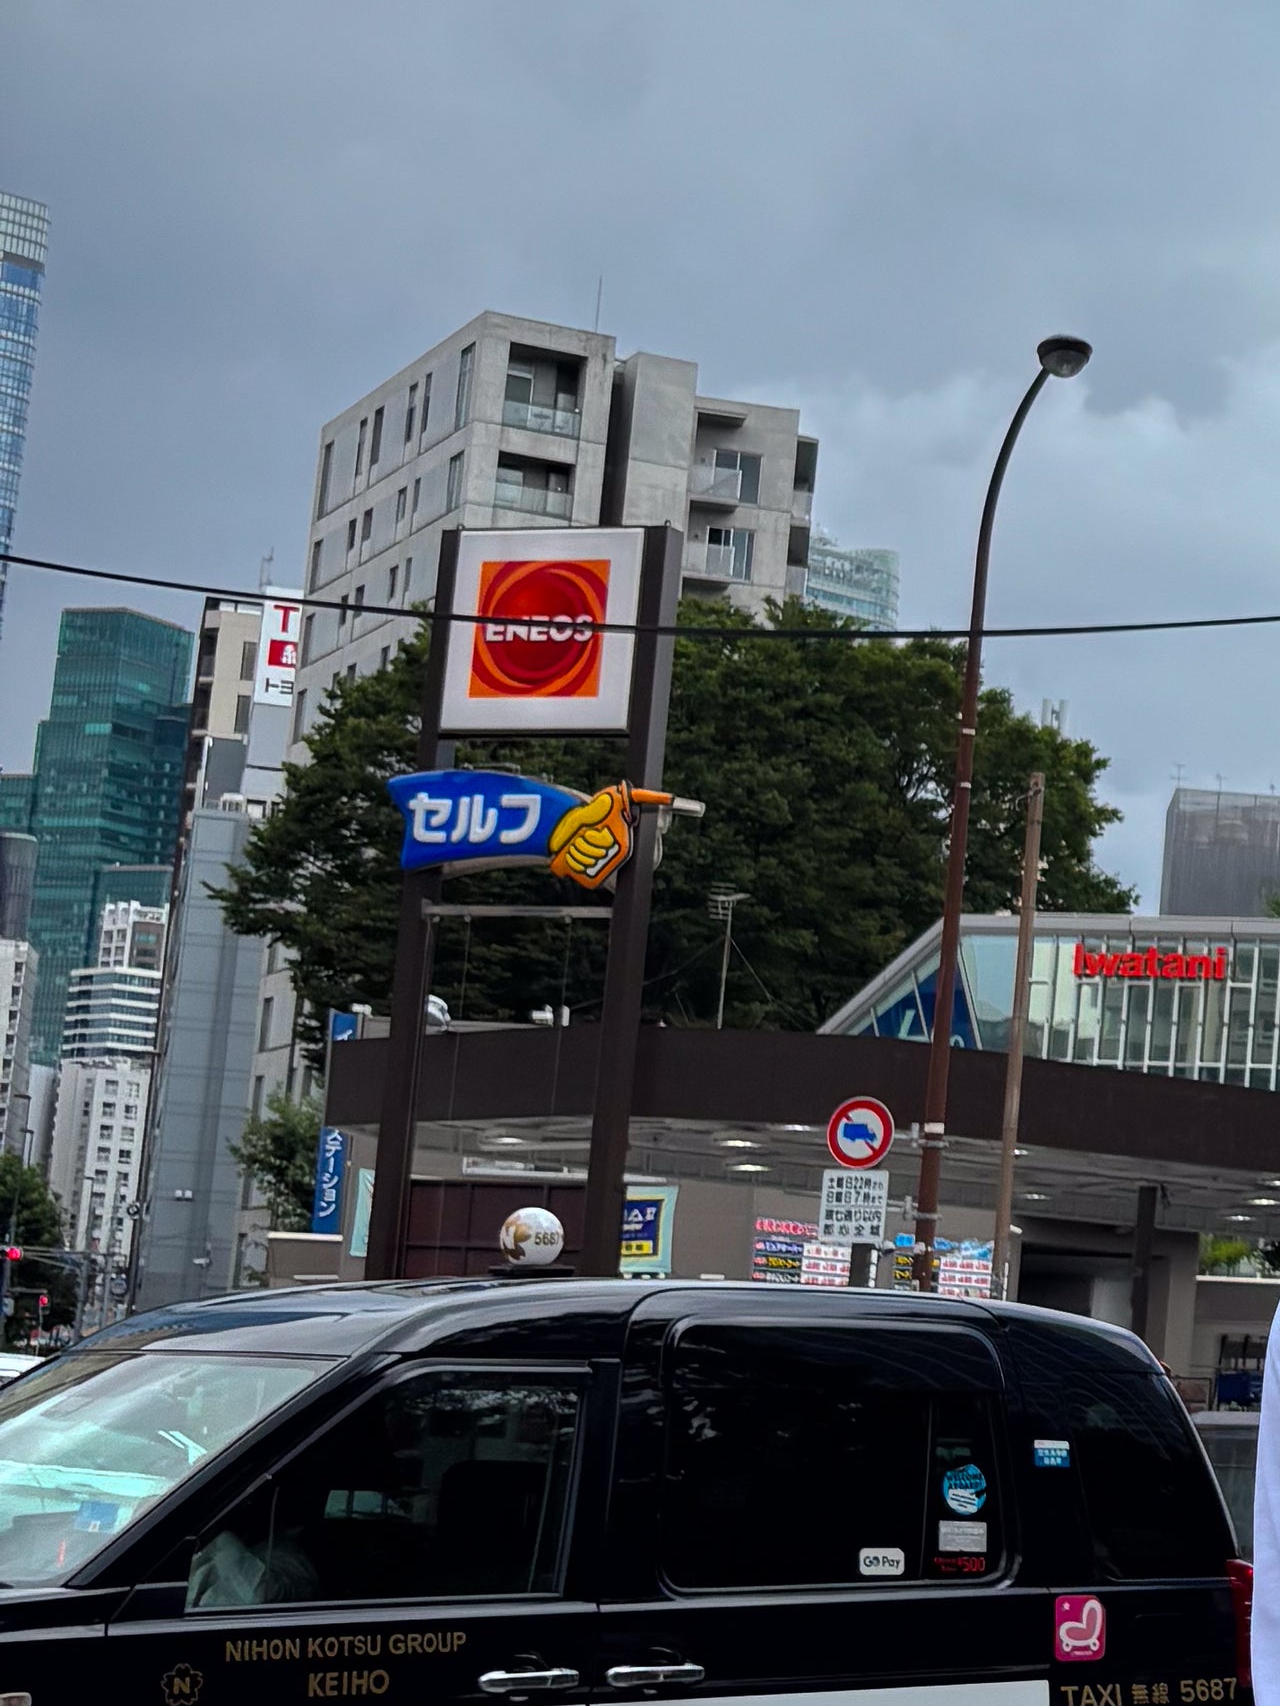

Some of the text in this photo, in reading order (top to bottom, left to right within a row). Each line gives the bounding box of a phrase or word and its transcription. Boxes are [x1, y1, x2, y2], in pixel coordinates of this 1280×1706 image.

[485, 614, 594, 642] ENEOS
[408, 791, 542, 844] セルフ
[1072, 942, 1227, 980] Iwatani
[225, 1631, 467, 1662] NIHON KOTSU GROUP
[307, 1669, 390, 1698] KEIHO
[1179, 1677, 1238, 1703] 5687
